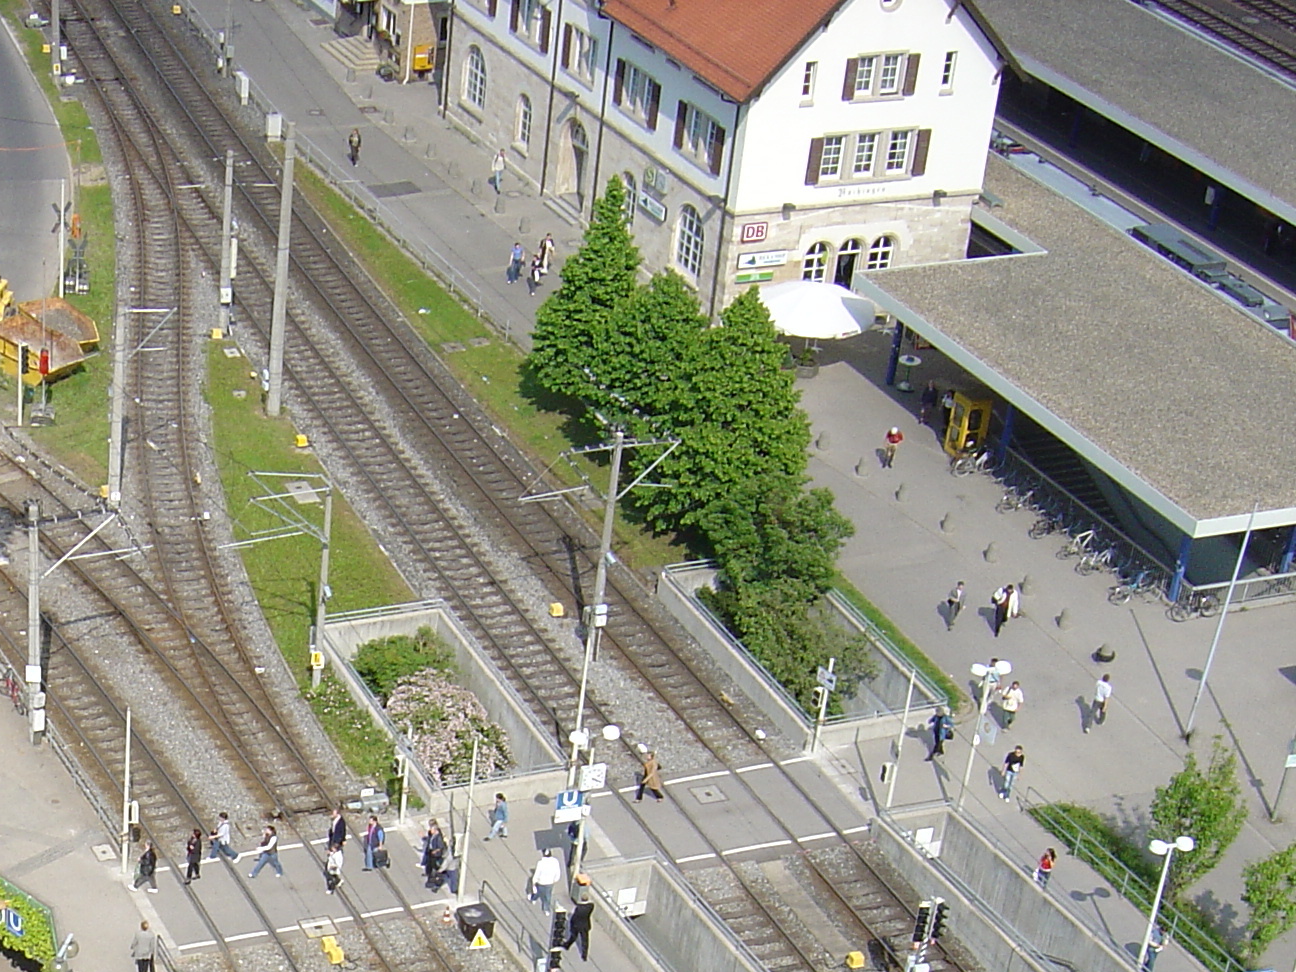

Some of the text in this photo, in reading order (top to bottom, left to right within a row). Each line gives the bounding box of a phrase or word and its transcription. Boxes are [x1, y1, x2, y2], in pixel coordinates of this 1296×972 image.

[746, 225, 765, 239] DB
[563, 790, 579, 807] U
[9, 911, 22, 932] U
